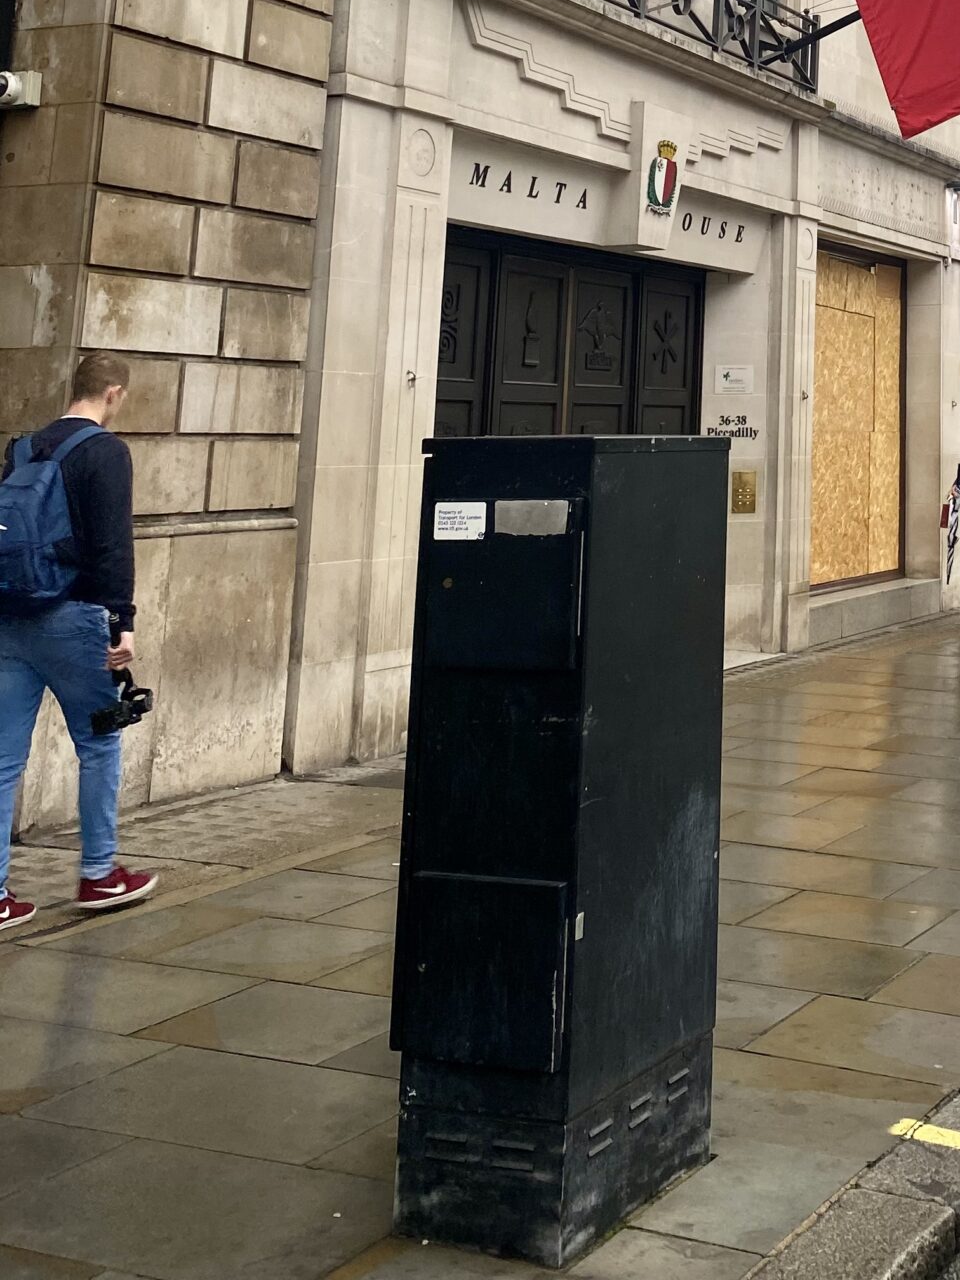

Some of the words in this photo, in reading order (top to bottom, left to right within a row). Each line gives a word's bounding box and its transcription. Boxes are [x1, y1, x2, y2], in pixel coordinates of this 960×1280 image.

[469, 162, 588, 210] MALTA
[681, 212, 745, 243] OUSE
[718, 415, 747, 426] 36-38
[706, 427, 760, 440] Piccadilly
